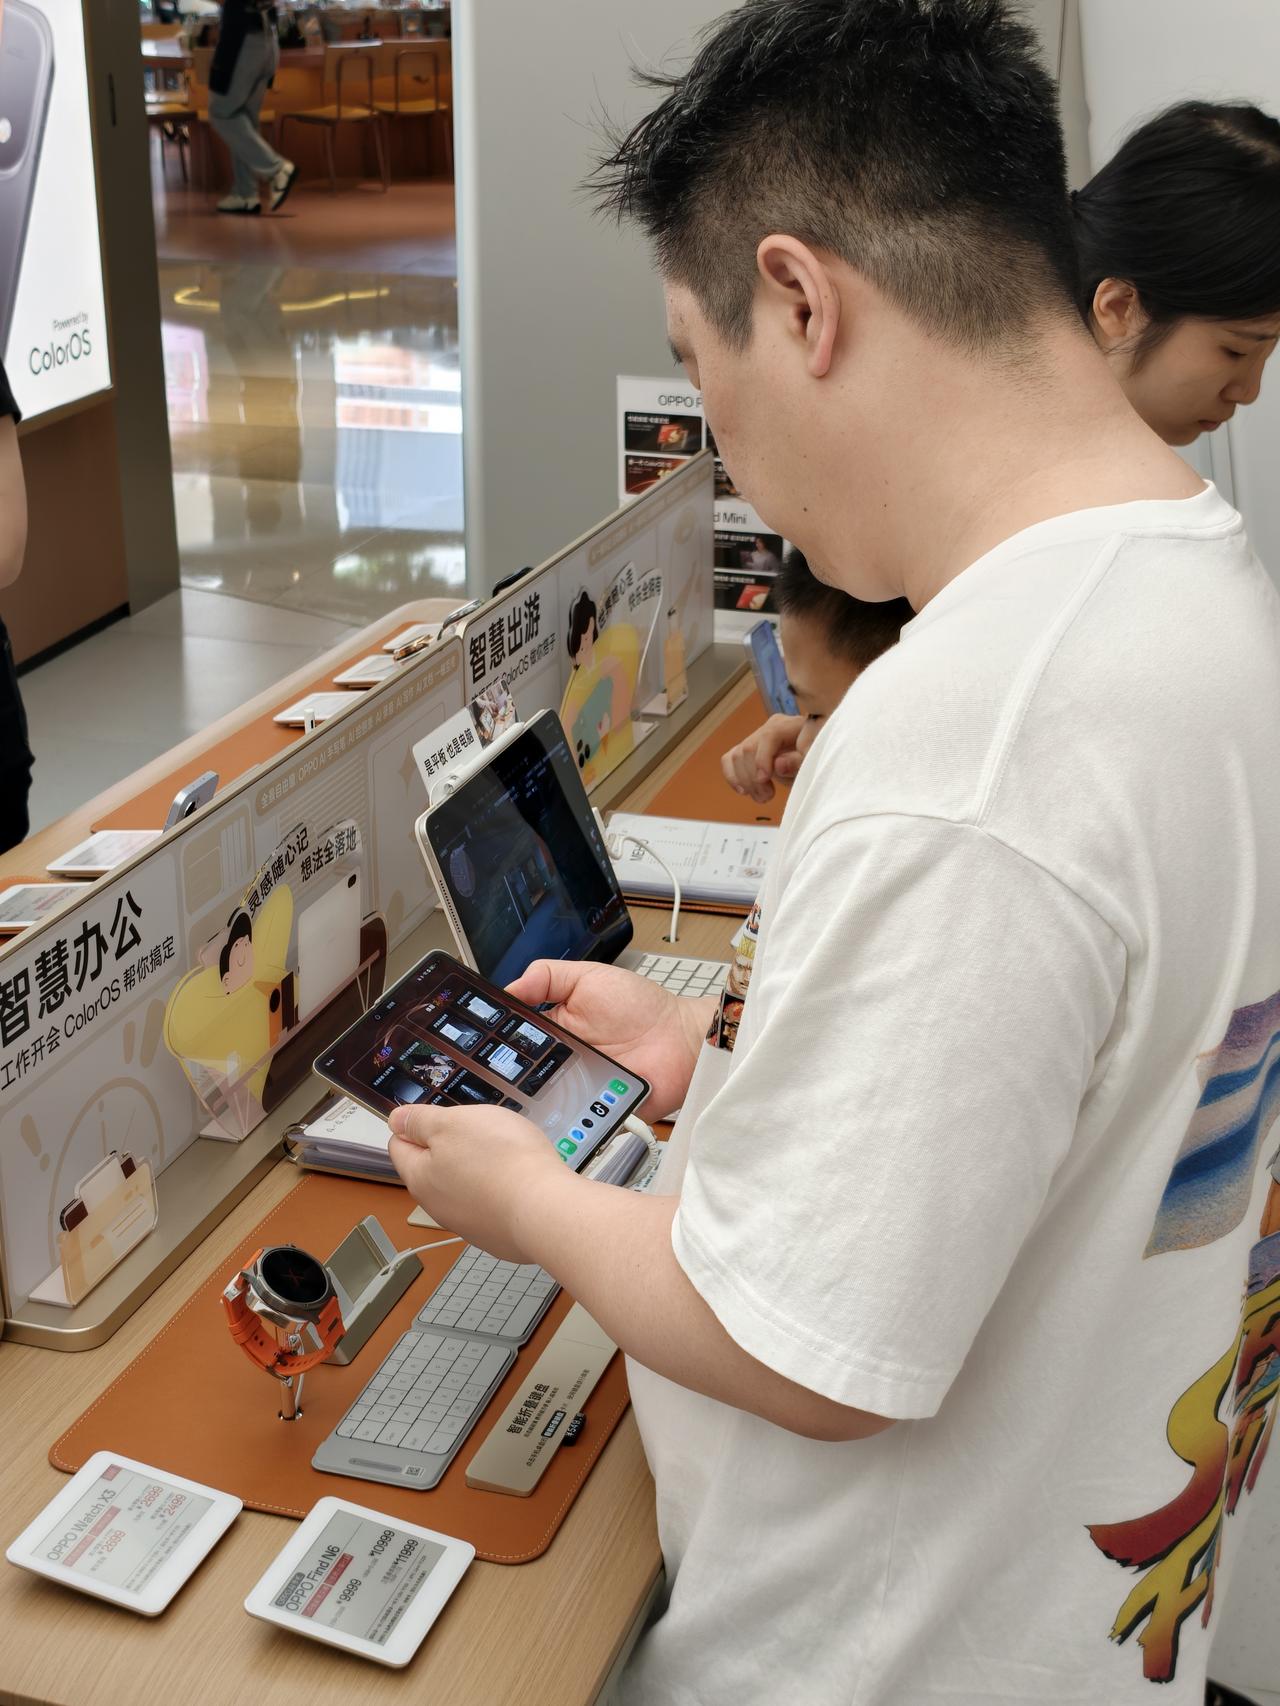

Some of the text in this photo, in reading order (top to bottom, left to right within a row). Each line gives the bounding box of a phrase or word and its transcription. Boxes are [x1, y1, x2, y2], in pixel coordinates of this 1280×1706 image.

[29, 329, 91, 375] ColorOS
[658, 394, 694, 408] OPPO
[469, 592, 540, 684] 智慧出游
[248, 827, 309, 918] 灵感随心记
[301, 826, 357, 883] 想法全落地
[0, 890, 142, 1049] 智慧办公
[1, 935, 175, 1090] 工作开会 ColorOS 帮你搞定
[47, 1532, 78, 1561] OPPO
[71, 1503, 105, 1531] Watch
[286, 1581, 314, 1611] OPPO
[306, 1560, 330, 1582] Find
[321, 1544, 340, 1561] N6
